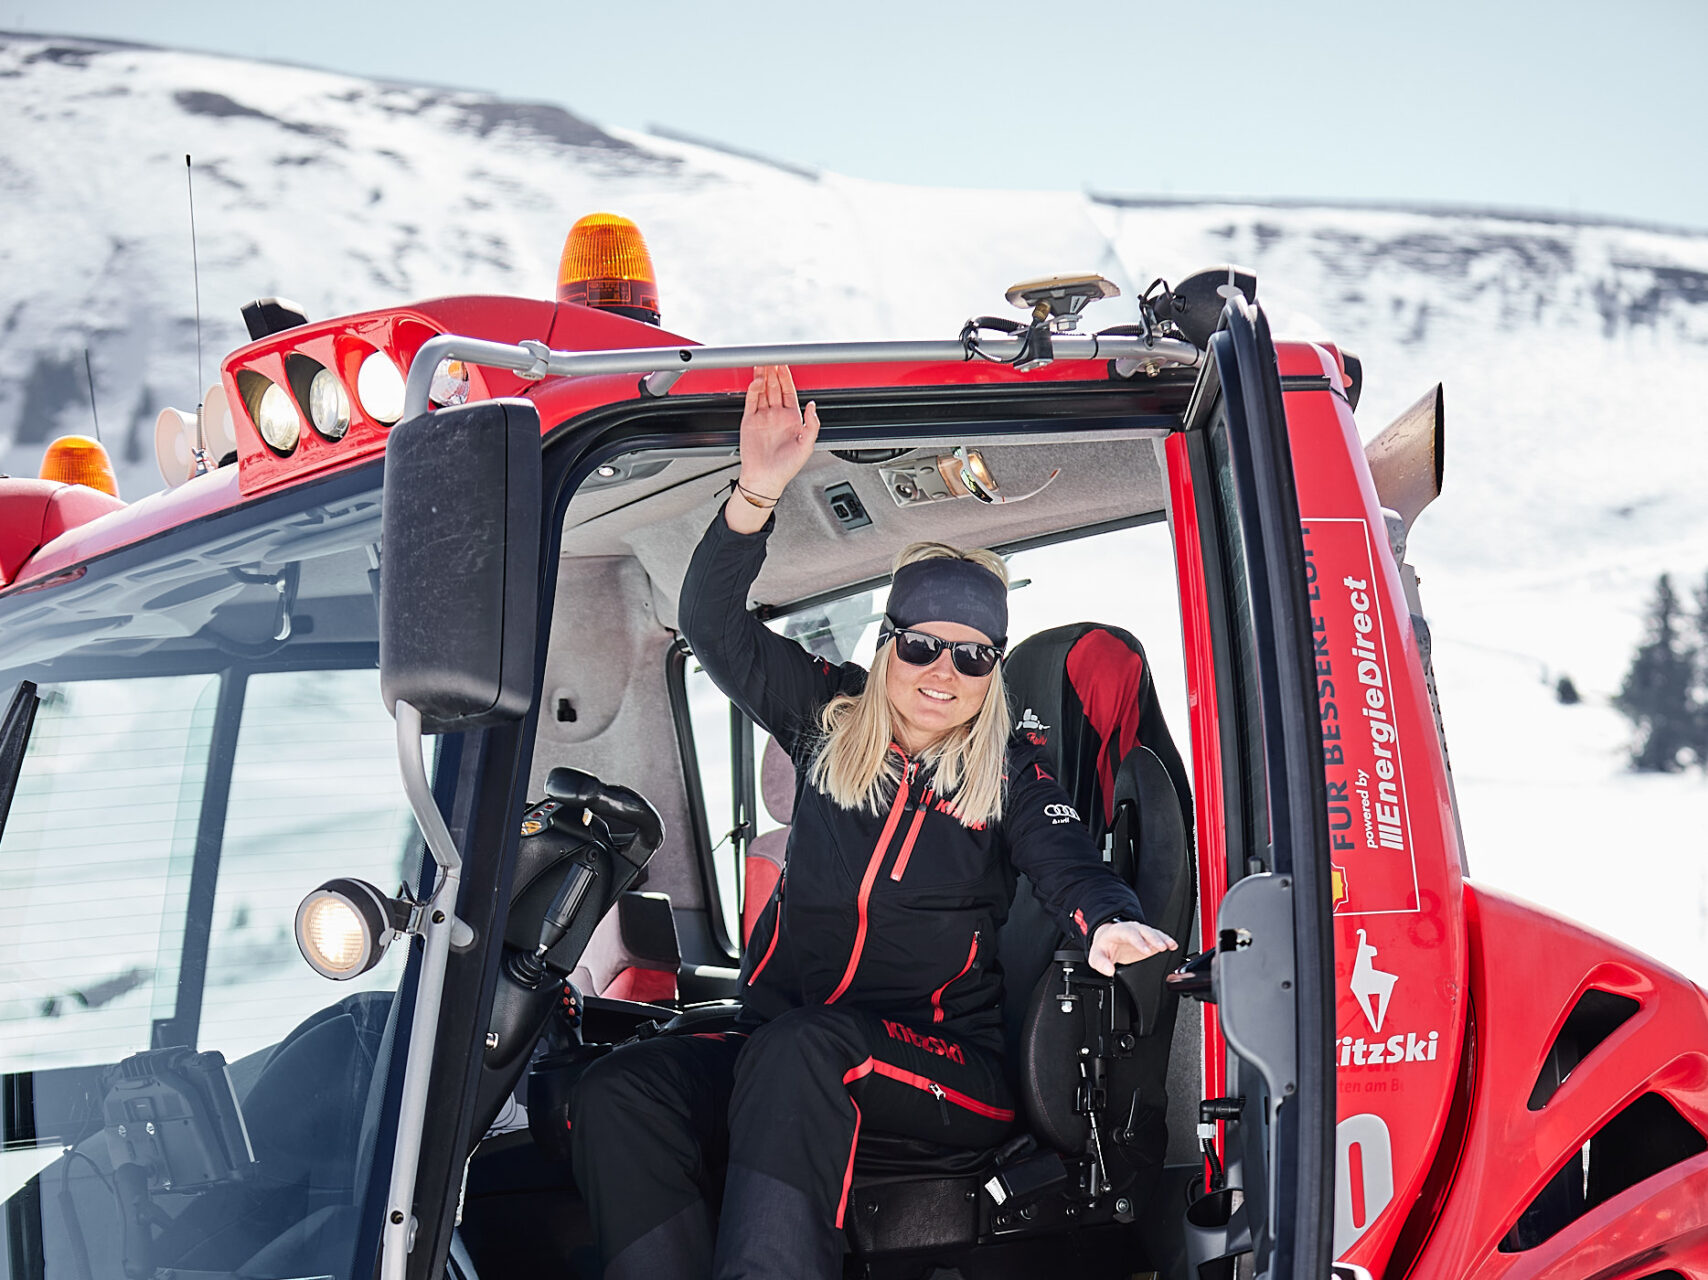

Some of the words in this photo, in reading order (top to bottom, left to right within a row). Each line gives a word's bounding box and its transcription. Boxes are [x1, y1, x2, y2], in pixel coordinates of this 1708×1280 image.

[1344, 576, 1401, 826] EnergieDirect
[1355, 769, 1370, 787] by
[1356, 789, 1378, 849] powered
[1336, 1031, 1439, 1067] itzSki
